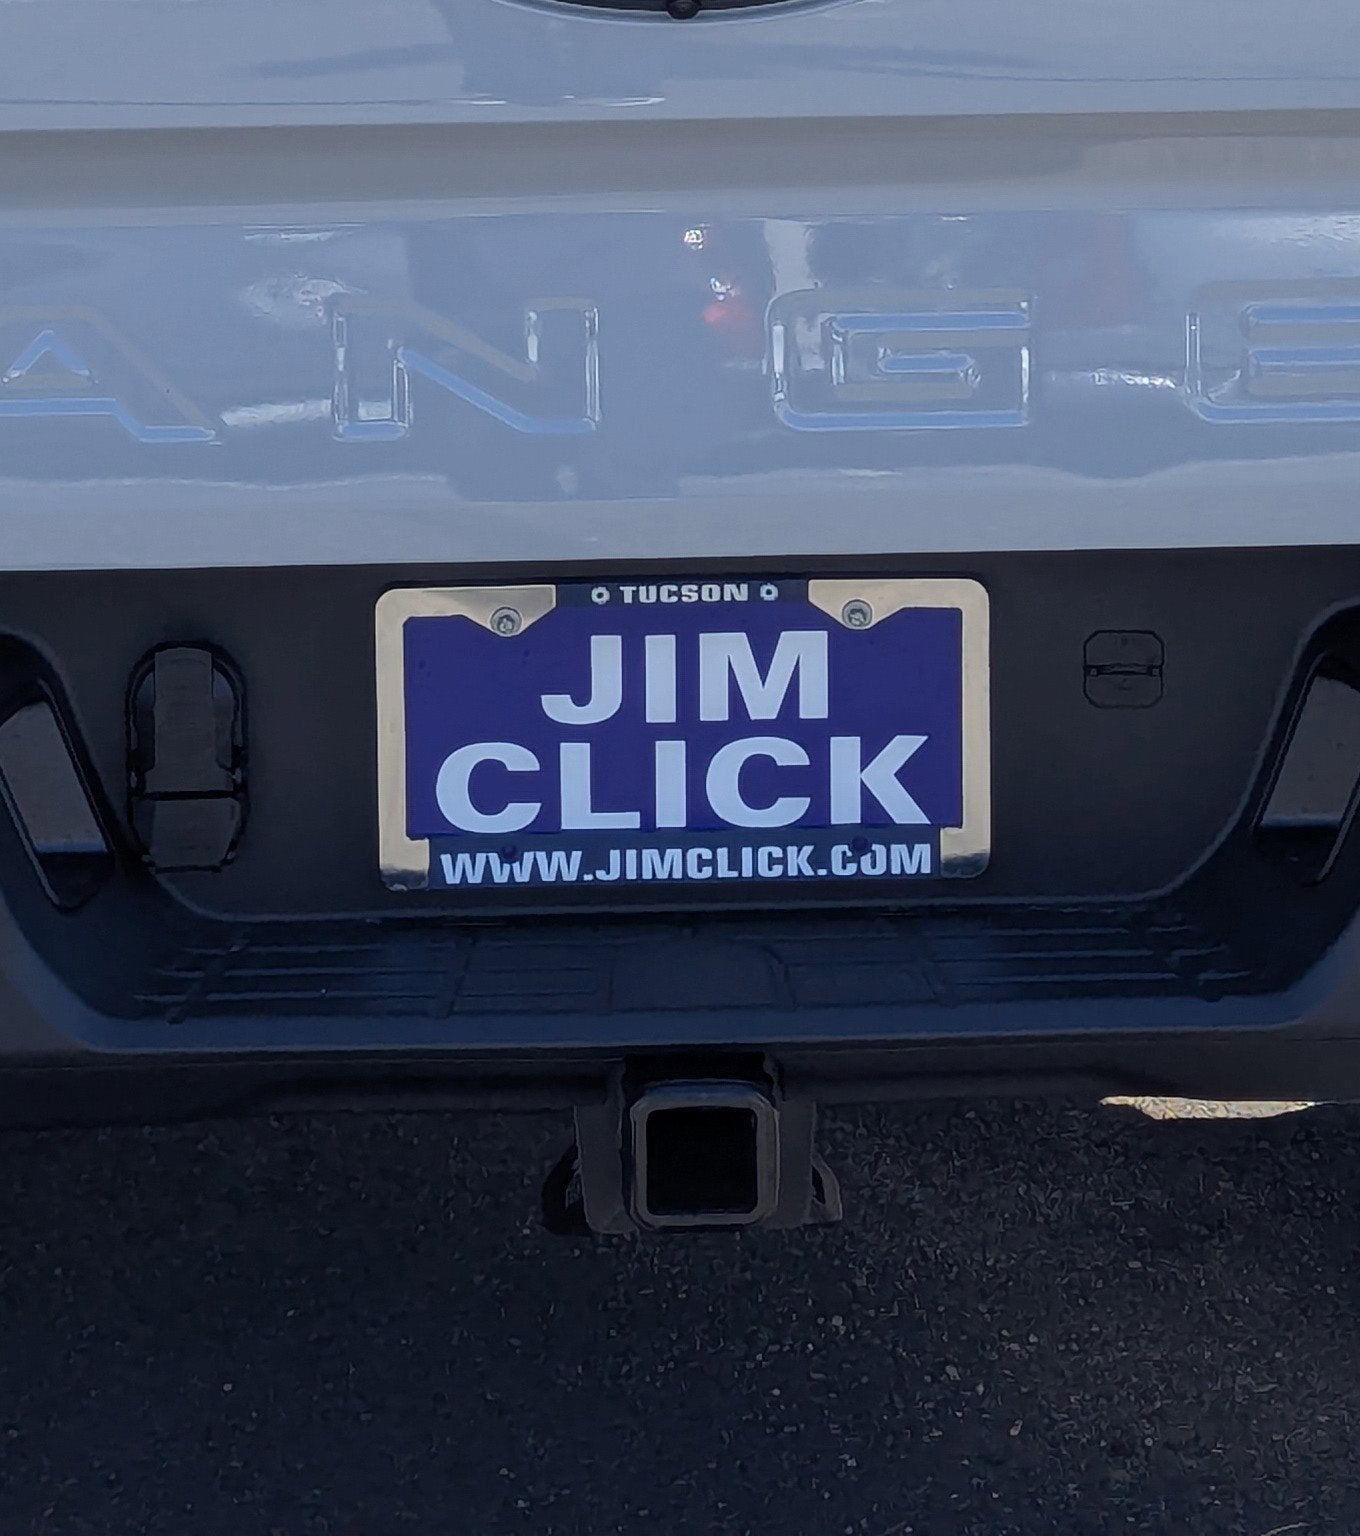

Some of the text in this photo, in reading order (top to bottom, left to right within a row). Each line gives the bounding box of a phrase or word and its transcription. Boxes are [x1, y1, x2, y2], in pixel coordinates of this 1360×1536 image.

[619, 583, 749, 604] TUCSON
[540, 630, 829, 725] JIM
[435, 734, 932, 833] CLICK
[439, 843, 932, 885] WWW.JIMCLICK.COM
